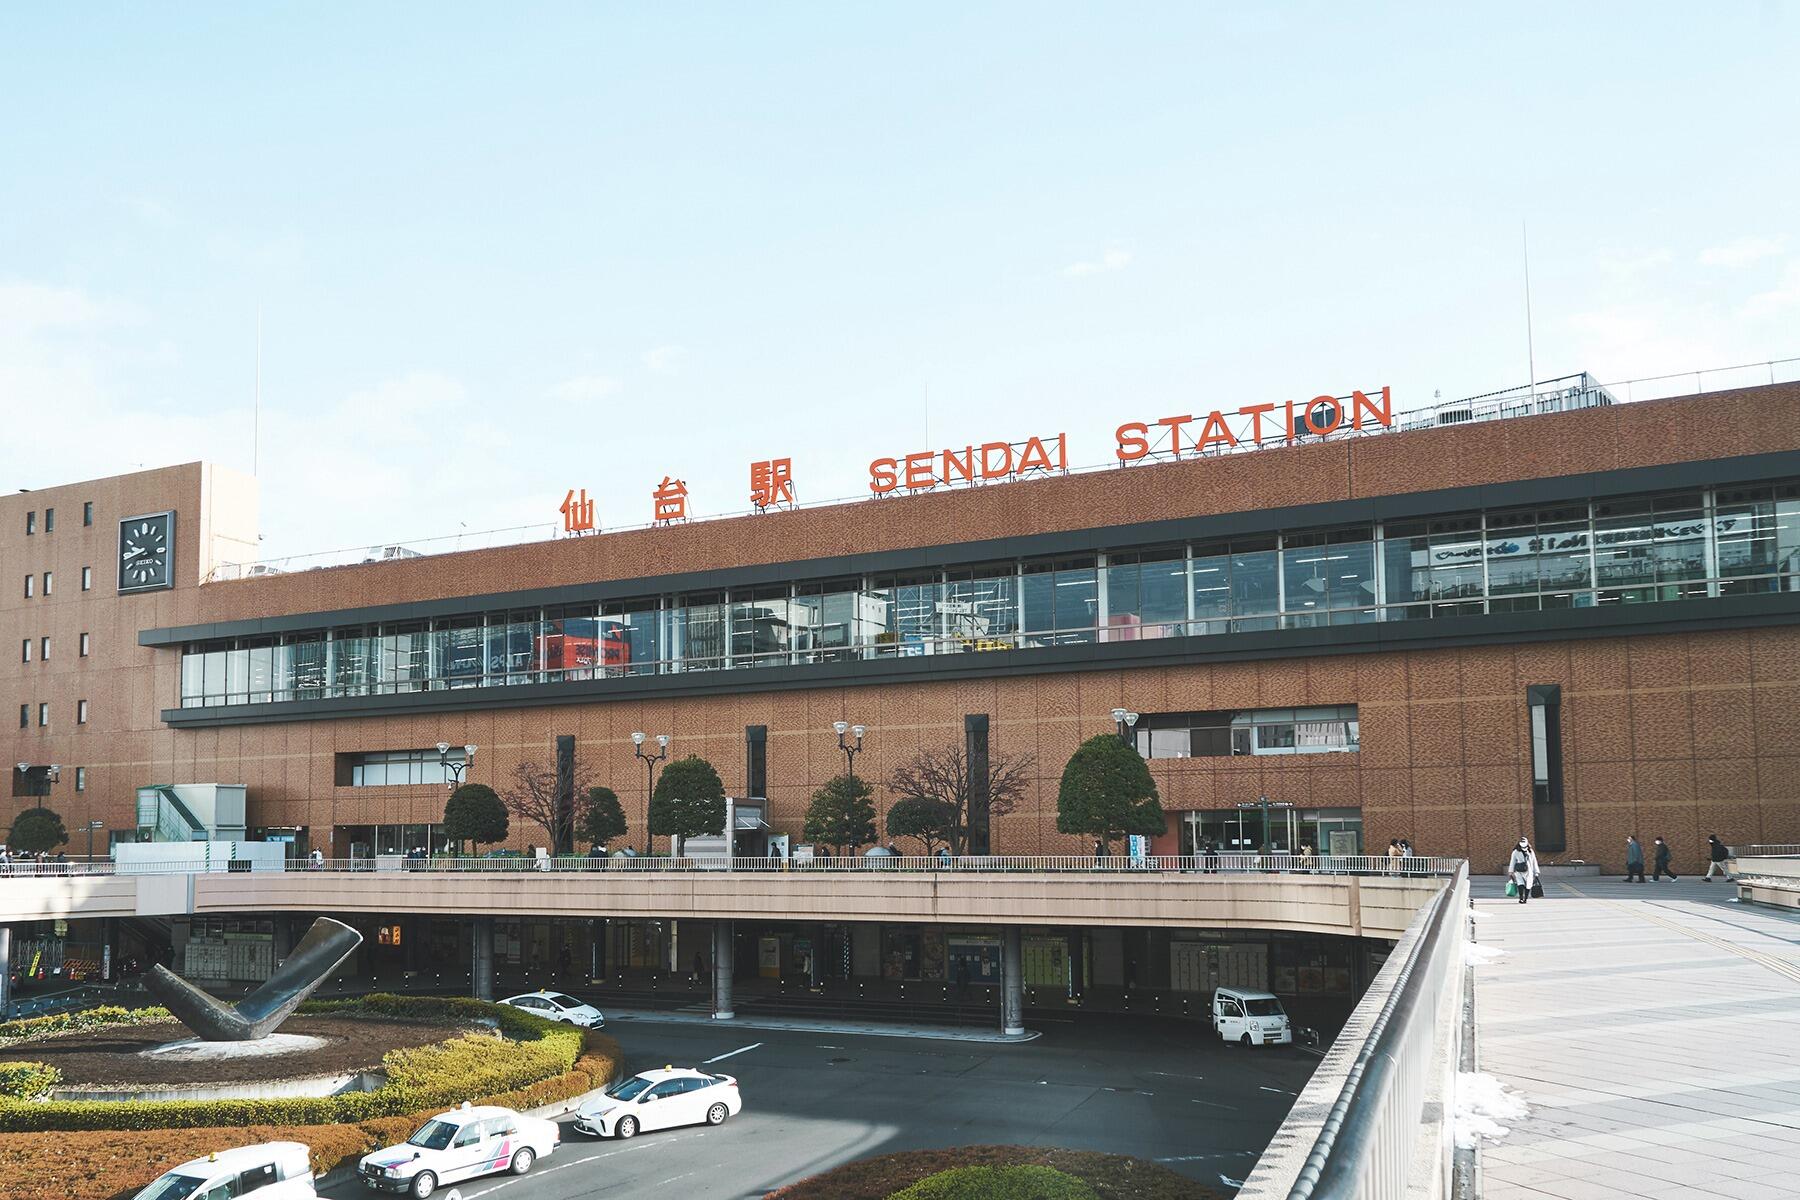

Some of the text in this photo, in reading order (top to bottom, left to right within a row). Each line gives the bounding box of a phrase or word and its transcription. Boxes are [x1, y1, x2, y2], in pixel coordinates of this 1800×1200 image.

[559, 386, 1392, 532] 仙台駅 SENDAI STATION
